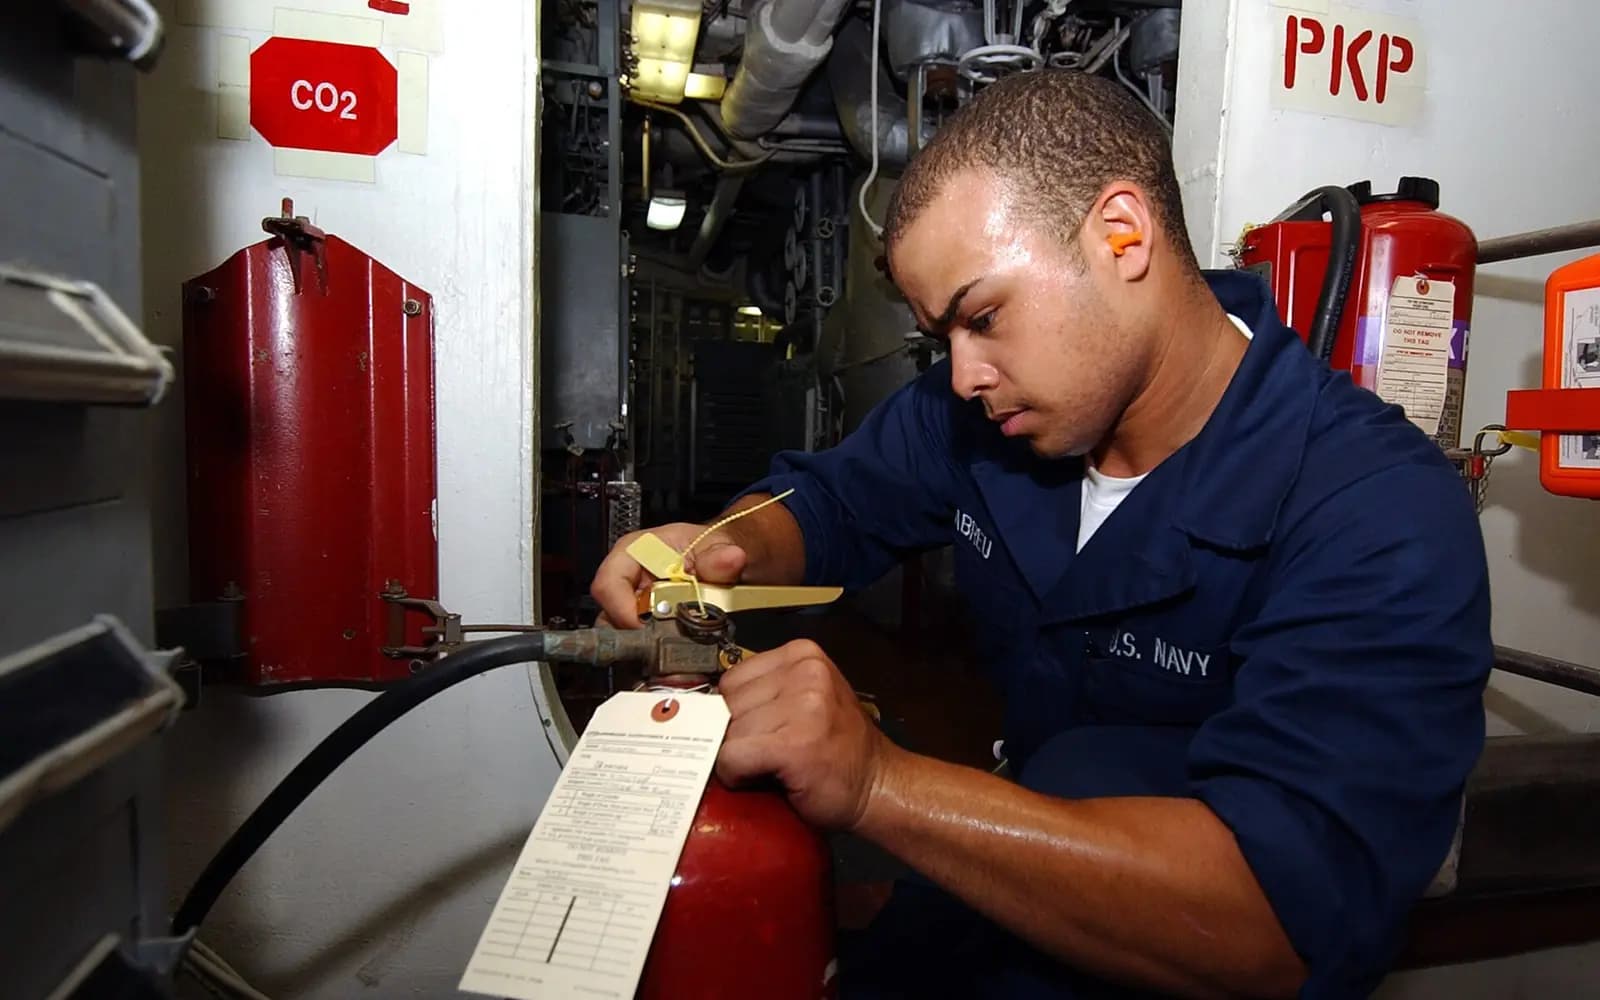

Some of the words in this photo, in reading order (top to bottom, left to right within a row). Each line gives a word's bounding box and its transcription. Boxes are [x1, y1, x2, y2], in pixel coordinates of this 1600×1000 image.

[1284, 14, 1414, 104] PKP
[291, 80, 357, 120] CO2
[1108, 627, 1141, 660] U.S.
[1153, 636, 1211, 677] NAVY
